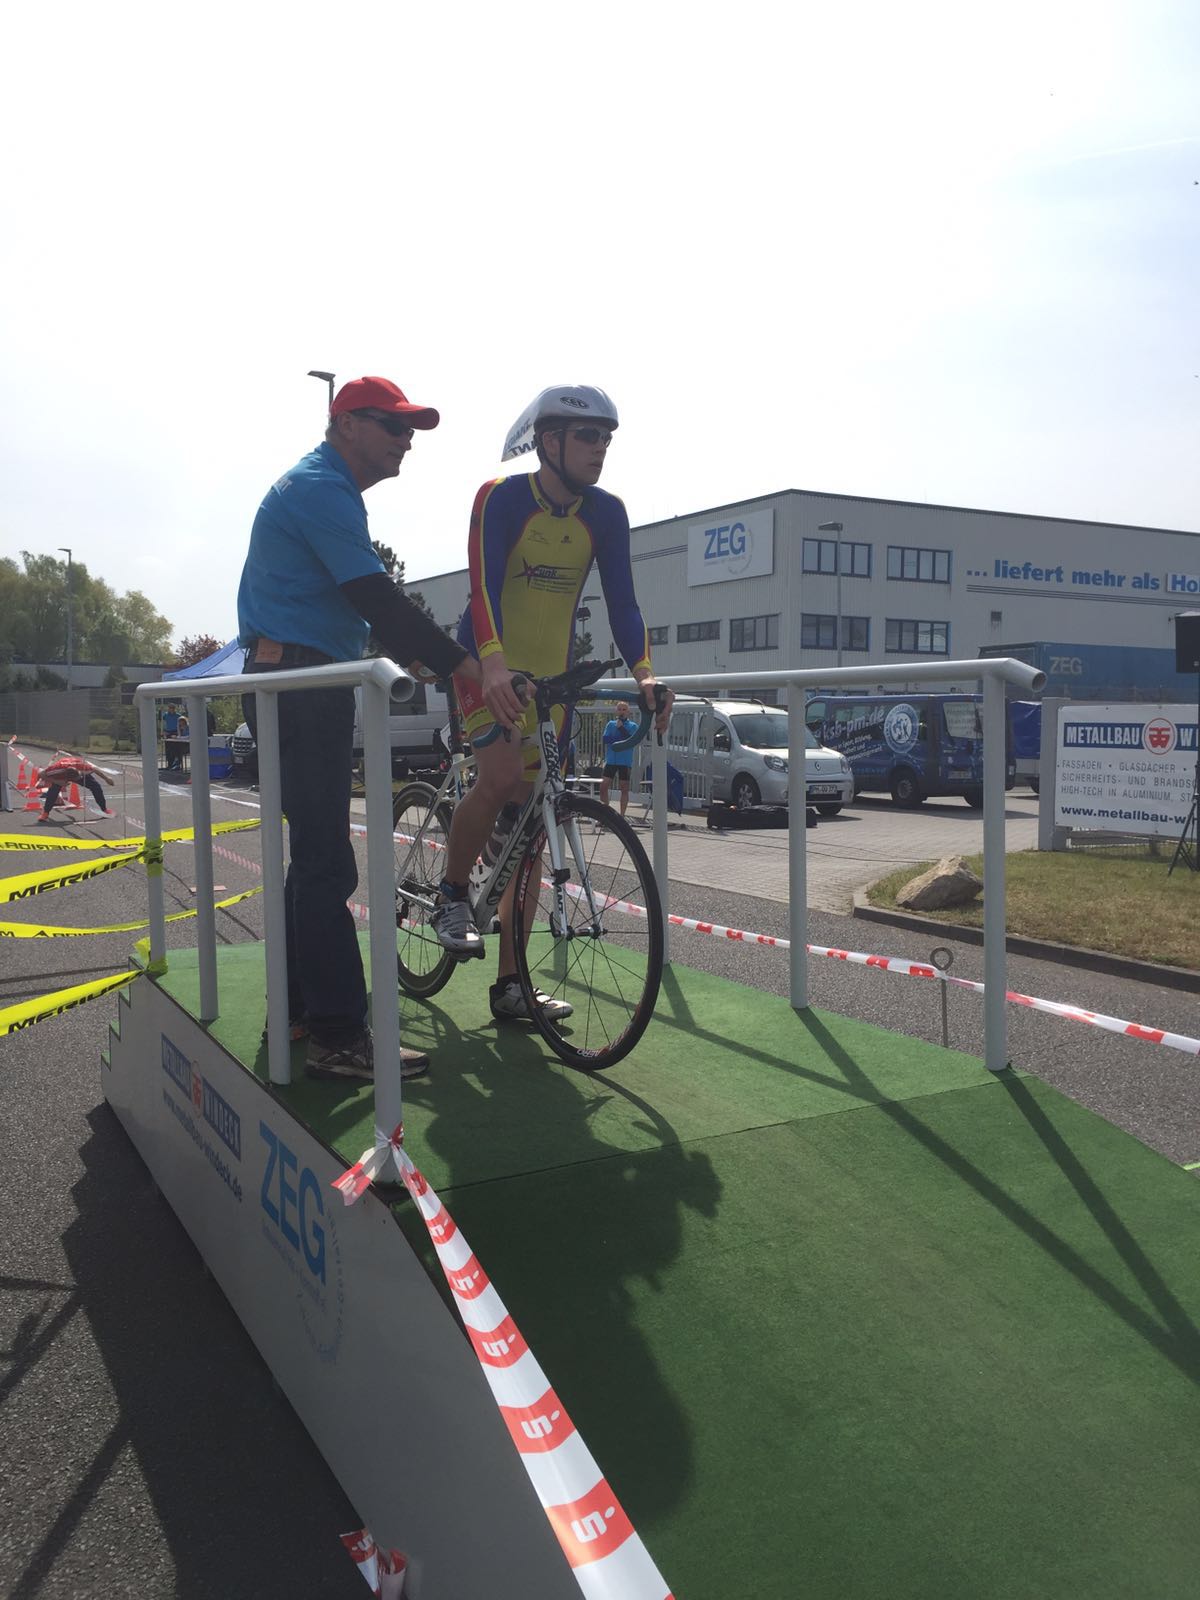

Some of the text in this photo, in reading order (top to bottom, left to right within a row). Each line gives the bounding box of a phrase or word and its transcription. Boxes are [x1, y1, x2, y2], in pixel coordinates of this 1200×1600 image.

[704, 522, 746, 560] ZEG
[994, 559, 1064, 583] liefert
[1072, 569, 1126, 588] mehr
[1131, 572, 1160, 590] als
[1171, 574, 1200, 592] Ho
[1050, 656, 1083, 675] ZEG
[1066, 726, 1140, 745] METALLBAU
[1061, 760, 1102, 770] FASSADEN
[1128, 776, 1146, 785] UND
[1061, 786, 1103, 796] HIGH-TECH
[1108, 789, 1117, 797] IN
[260, 1119, 327, 1287] ZEG
